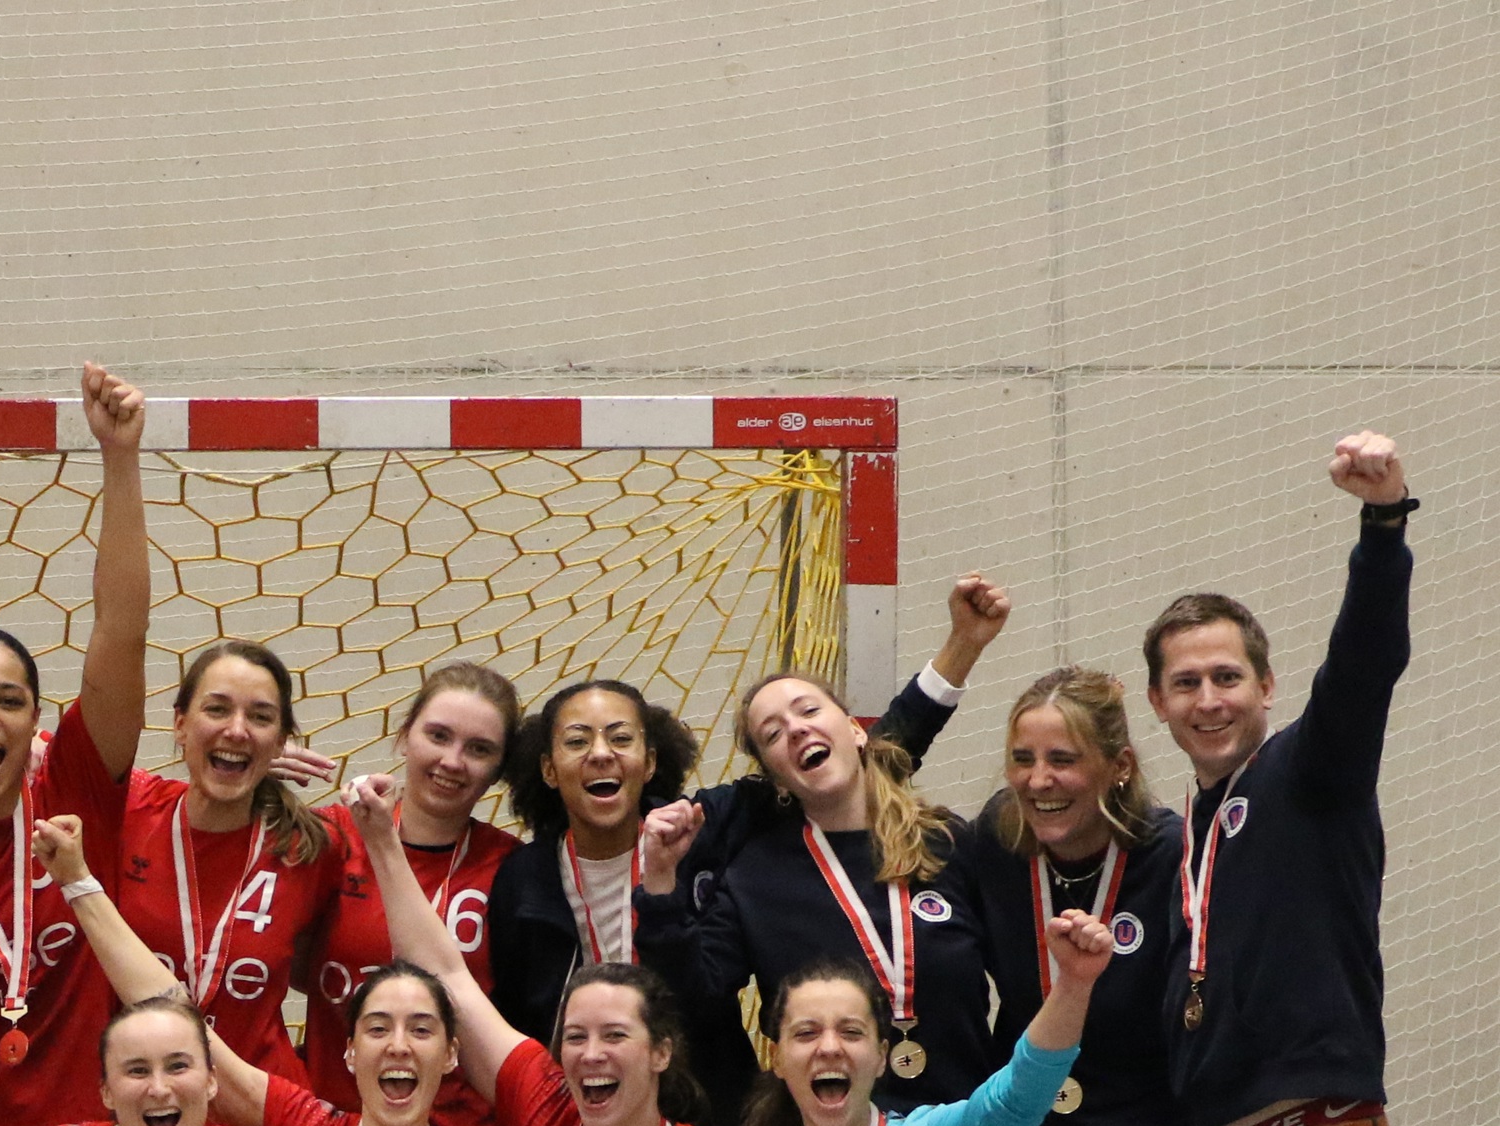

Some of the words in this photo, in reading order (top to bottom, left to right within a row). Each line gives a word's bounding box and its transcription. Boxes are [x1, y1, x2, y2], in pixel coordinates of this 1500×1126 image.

[737, 416, 773, 428] alder
[813, 416, 874, 428] eisenhut
[234, 870, 277, 933] 4
[447, 888, 489, 953] 6
[1117, 923, 1134, 944] U
